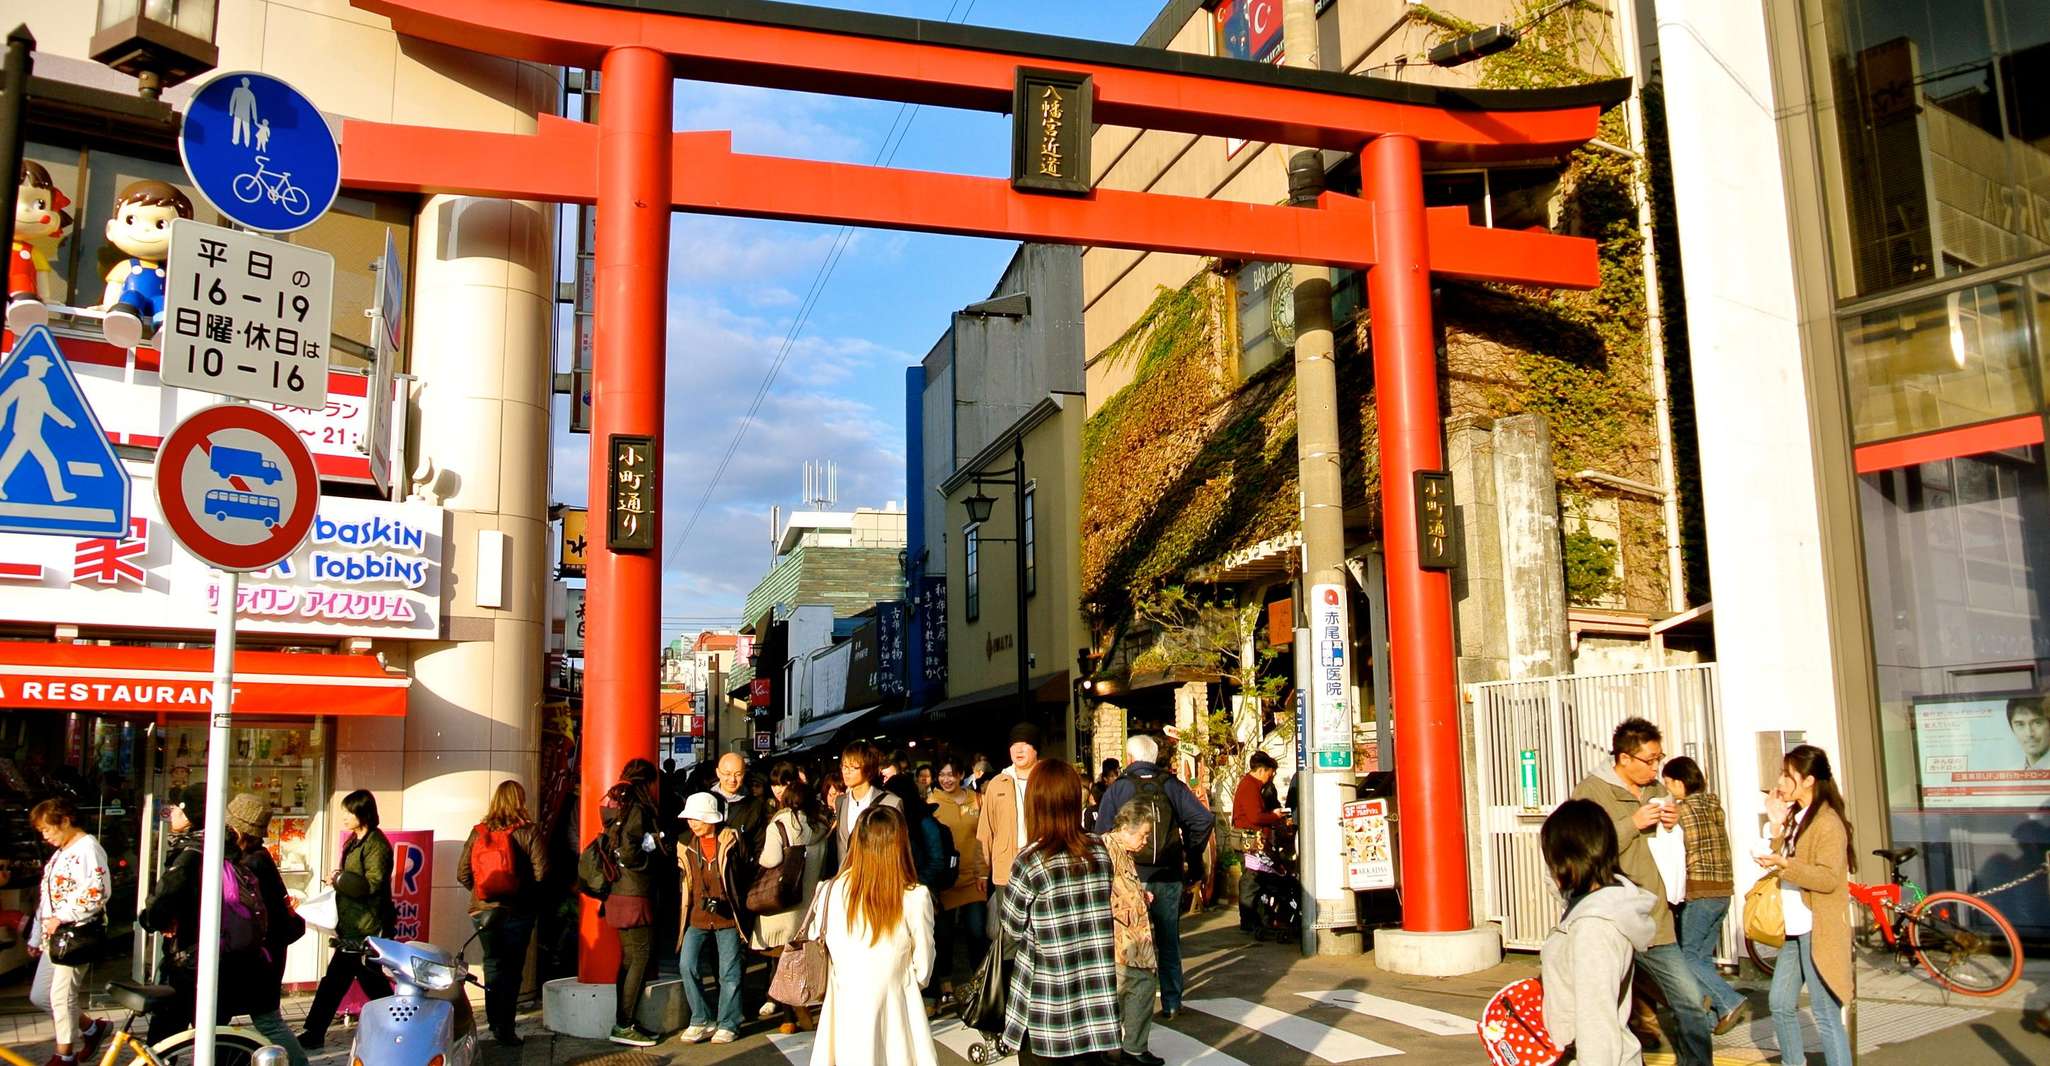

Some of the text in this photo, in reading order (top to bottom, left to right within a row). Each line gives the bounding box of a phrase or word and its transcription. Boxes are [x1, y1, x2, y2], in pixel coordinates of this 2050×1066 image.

[1040, 85, 1063, 177] 八幡宮近道
[1253, 265, 1268, 291] BAR
[176, 307, 321, 359] 日曜・休日は
[617, 446, 645, 537] 小町通り
[315, 515, 423, 549] baskin
[1425, 481, 1448, 557] 小町通り
[315, 554, 425, 584] robbins
[207, 584, 411, 618] サティワン アイスクリーム
